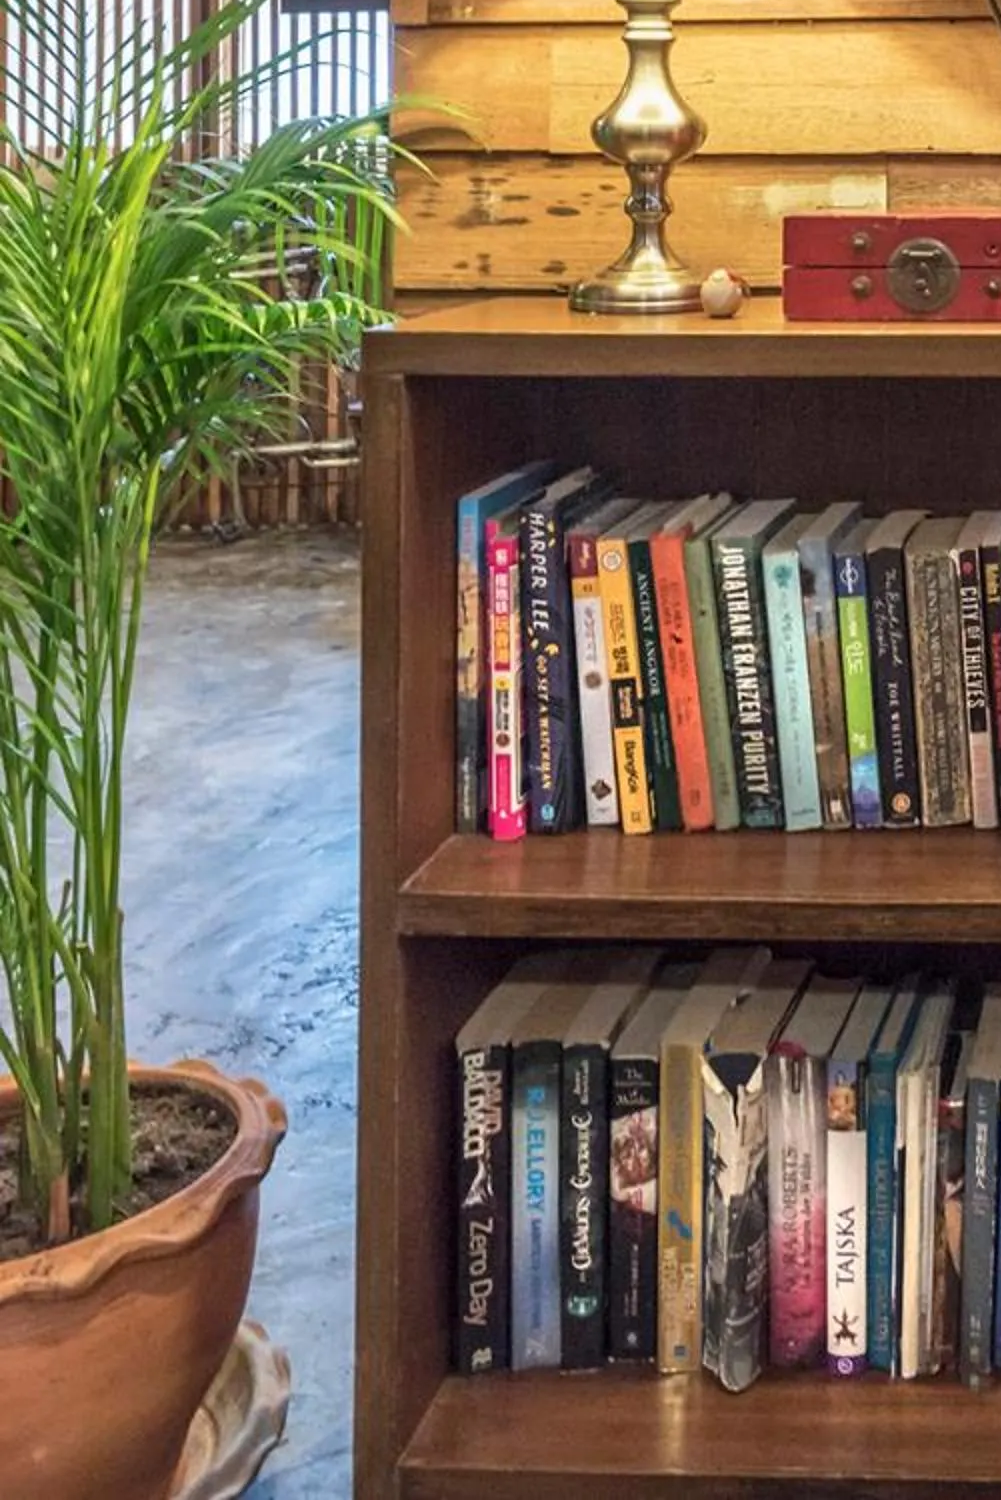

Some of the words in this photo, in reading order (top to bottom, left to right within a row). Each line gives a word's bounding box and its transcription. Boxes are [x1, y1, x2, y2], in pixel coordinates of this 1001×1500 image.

[529, 513, 547, 588] HARPER
[532, 599, 549, 631] LEE
[636, 572, 653, 632] ANCIENT
[721, 545, 751, 639] JONATHAN
[960, 587, 977, 620] CITY
[967, 626, 980, 639] OF
[536, 655, 545, 673] GO
[537, 678, 549, 699] SET
[644, 639, 660, 696] ANGKOR
[733, 644, 762, 724] FRANZEN
[965, 646, 984, 709] THIEVES
[540, 703, 548, 712] A
[539, 717, 553, 790] WATCHMAN
[742, 731, 769, 794] PURITY
[462, 1052, 485, 1160] BALDACCI
[484, 1070, 502, 1135] DAVID
[781, 1146, 799, 1232] ROBERTS
[469, 1219, 493, 1275] Zero
[835, 1206, 860, 1287] TAJSKA
[464, 1280, 492, 1326] Day
